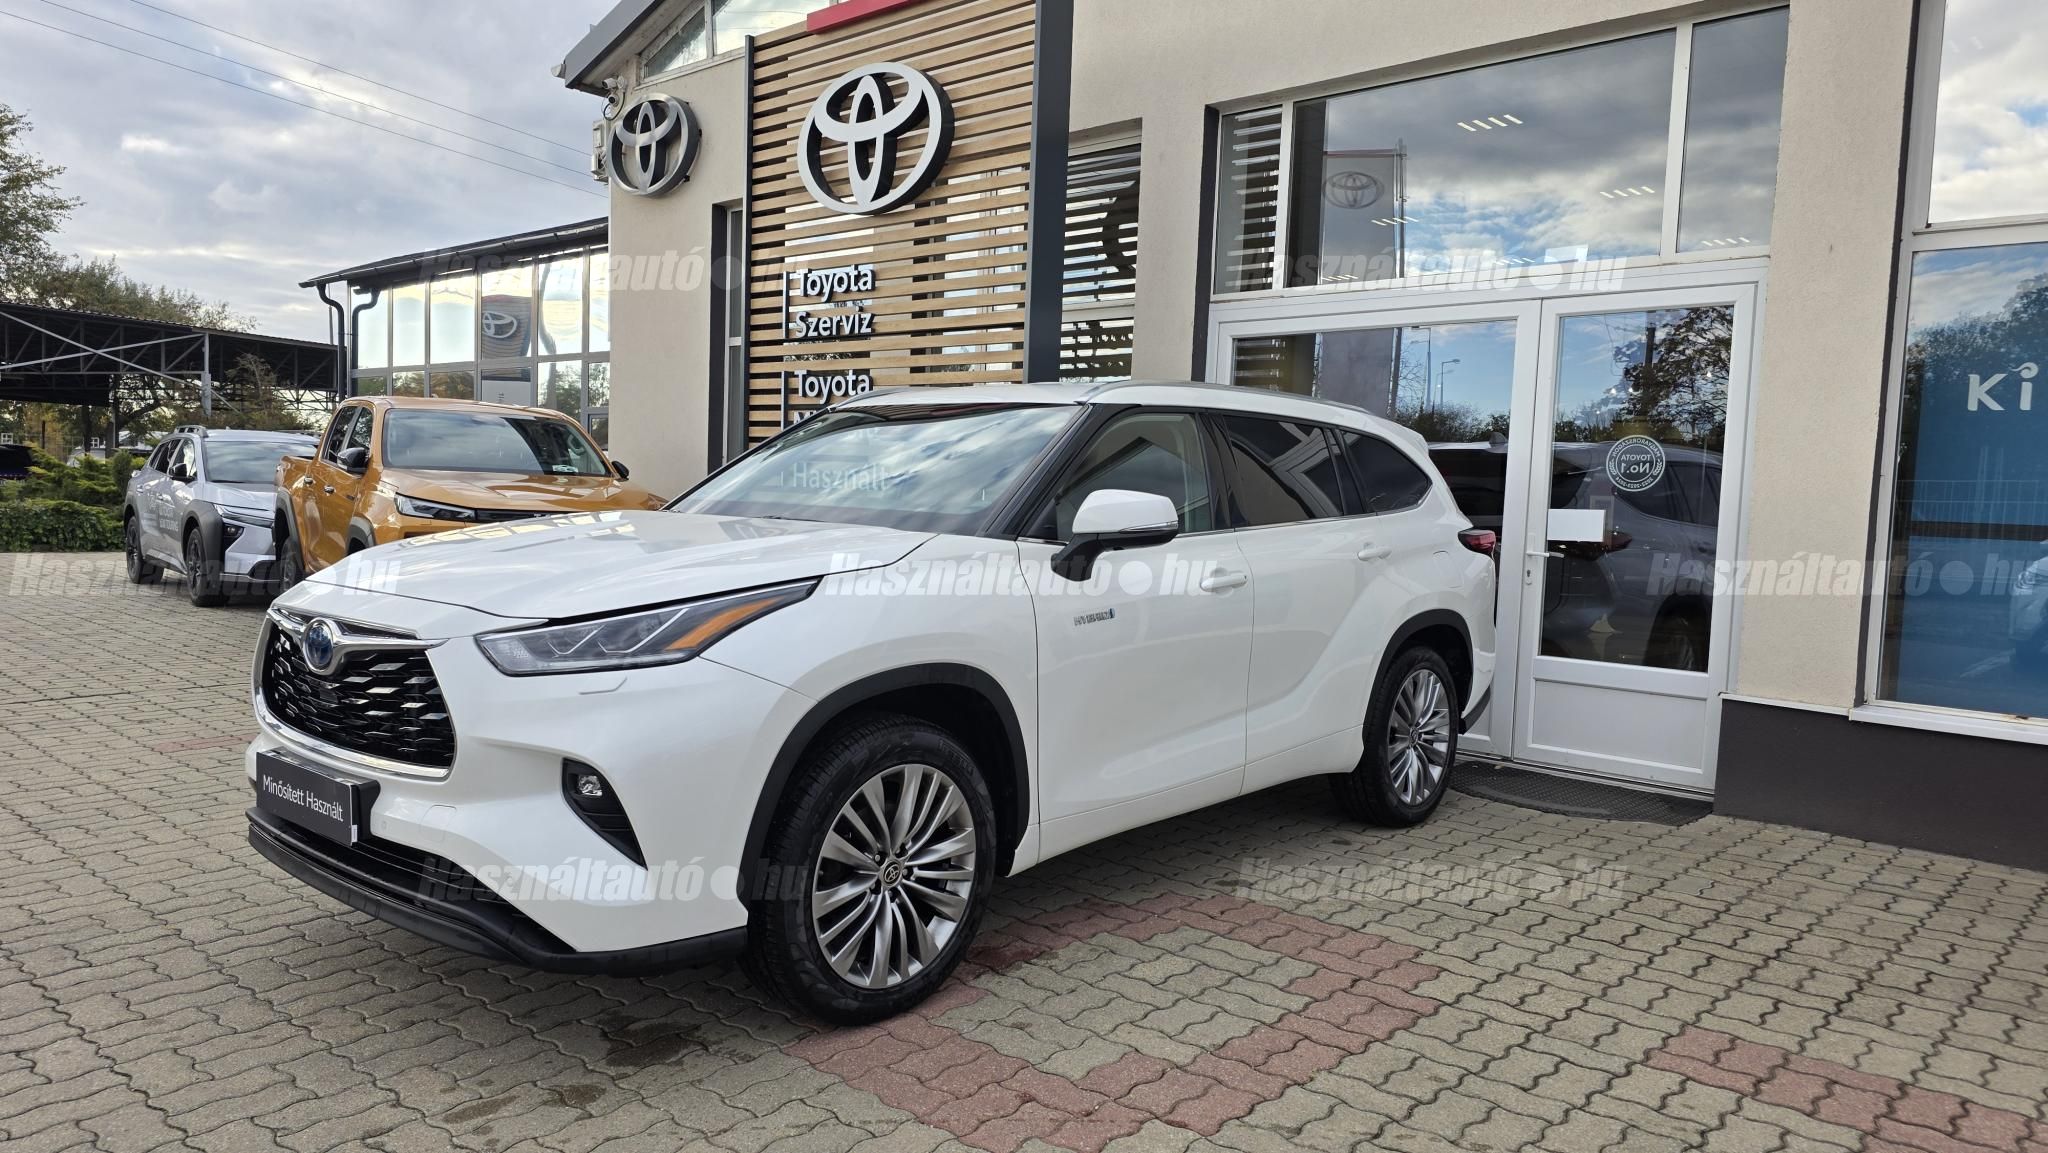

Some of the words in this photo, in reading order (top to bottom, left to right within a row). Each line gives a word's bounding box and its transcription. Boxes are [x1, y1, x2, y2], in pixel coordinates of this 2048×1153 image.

[796, 264, 874, 302] Toyota
[796, 306, 873, 338] Szerviz
[794, 369, 872, 404] Toyota
[263, 775, 304, 806] Minősített
[306, 790, 344, 822] Használt
